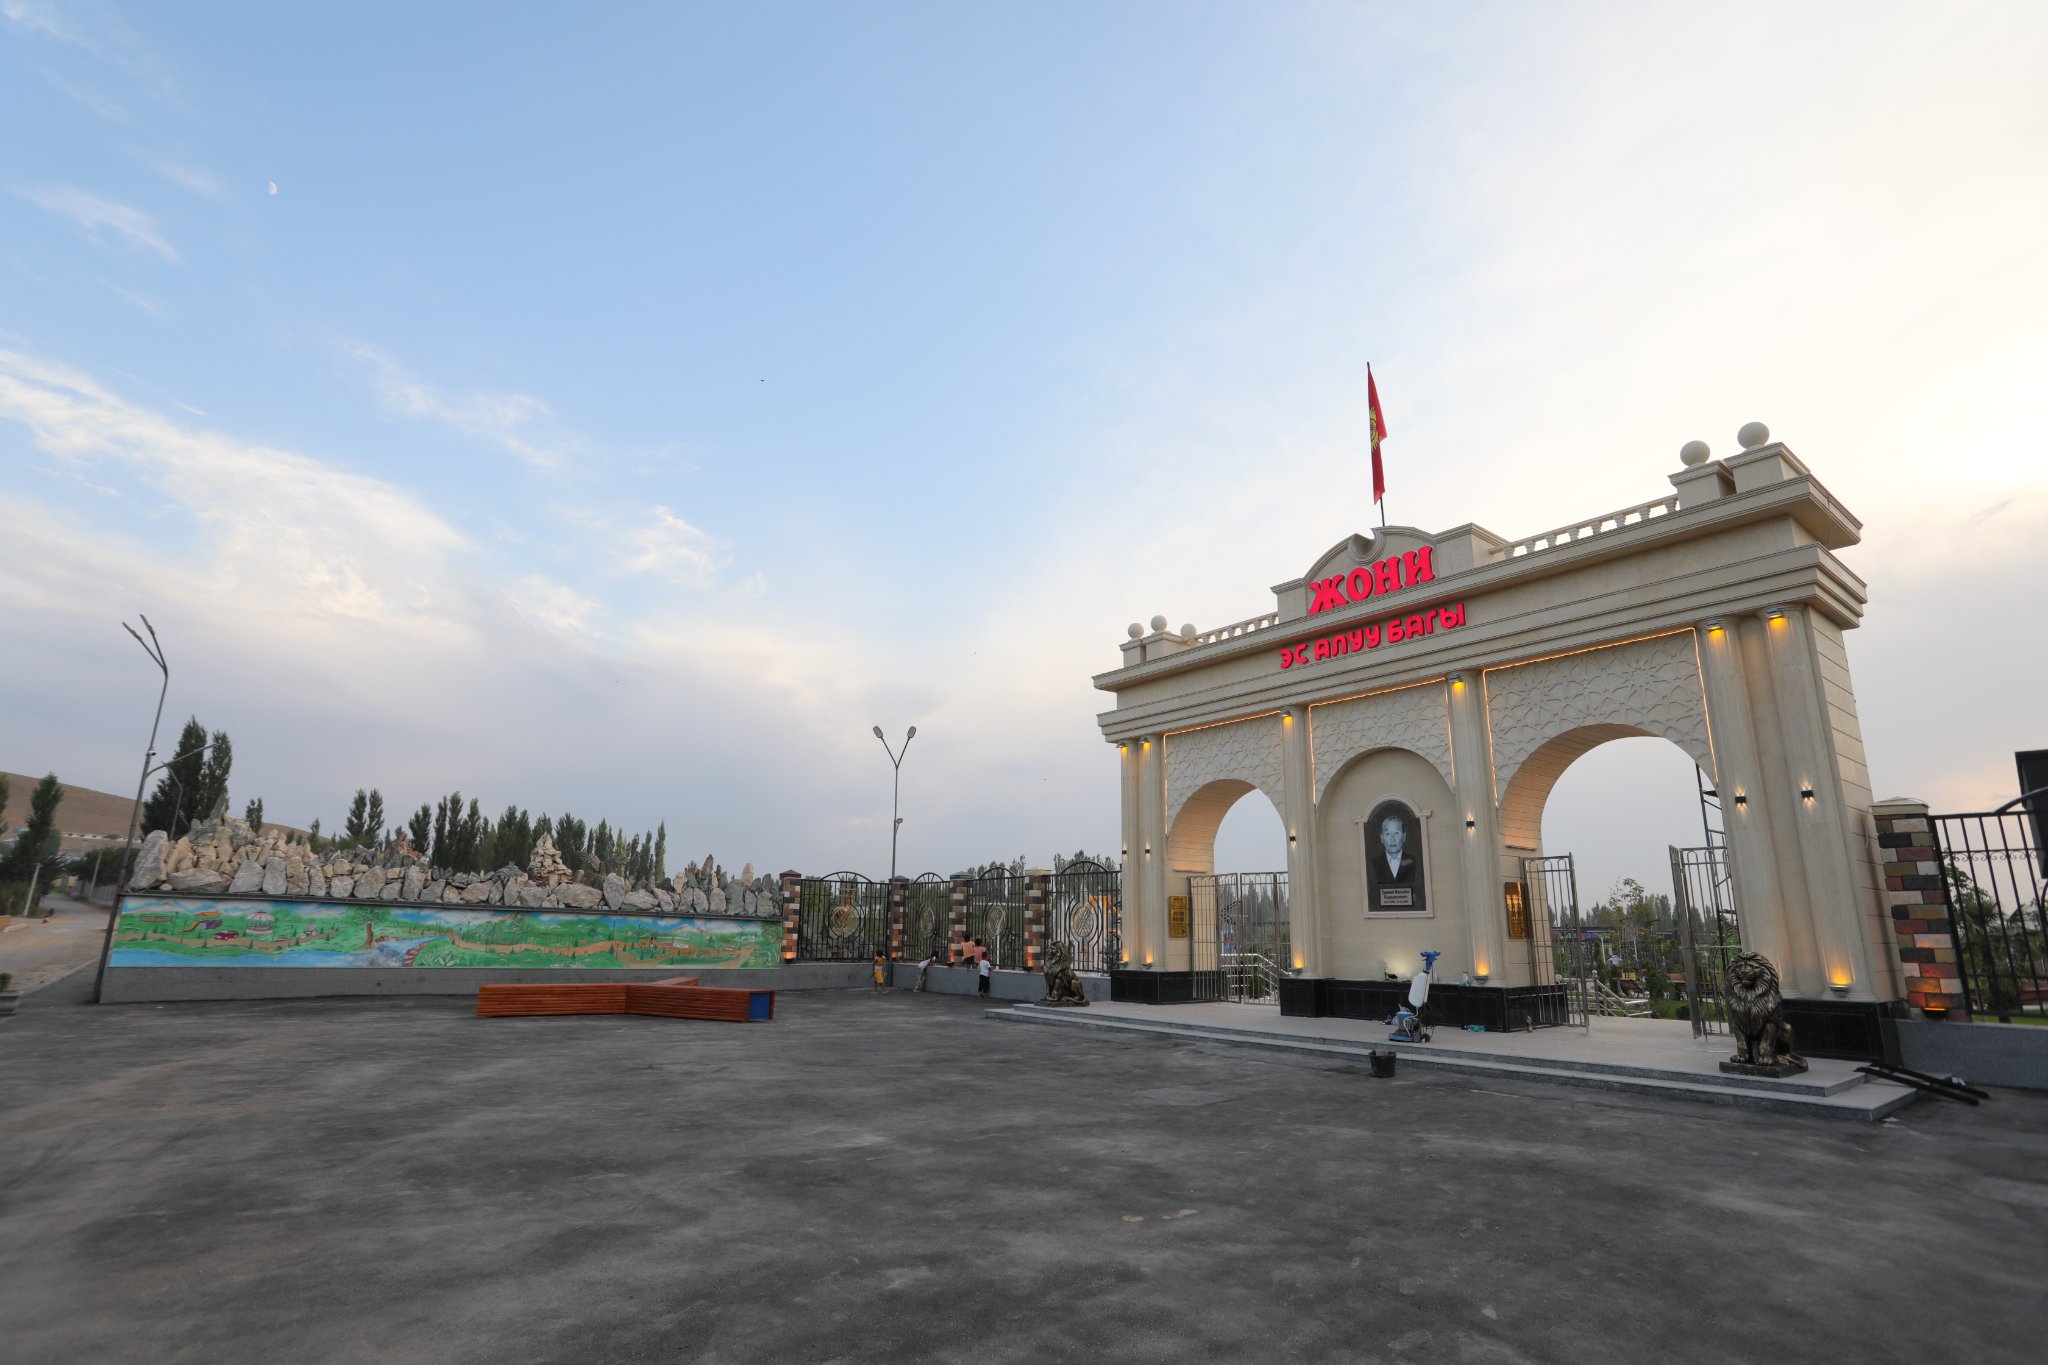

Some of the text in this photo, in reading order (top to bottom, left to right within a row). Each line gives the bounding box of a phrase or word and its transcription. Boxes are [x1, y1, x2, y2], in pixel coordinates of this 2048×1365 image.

[1308, 546, 1435, 615] ЖОНИ
[1279, 602, 1466, 669] ЭС АЛУУ БАГЫ
